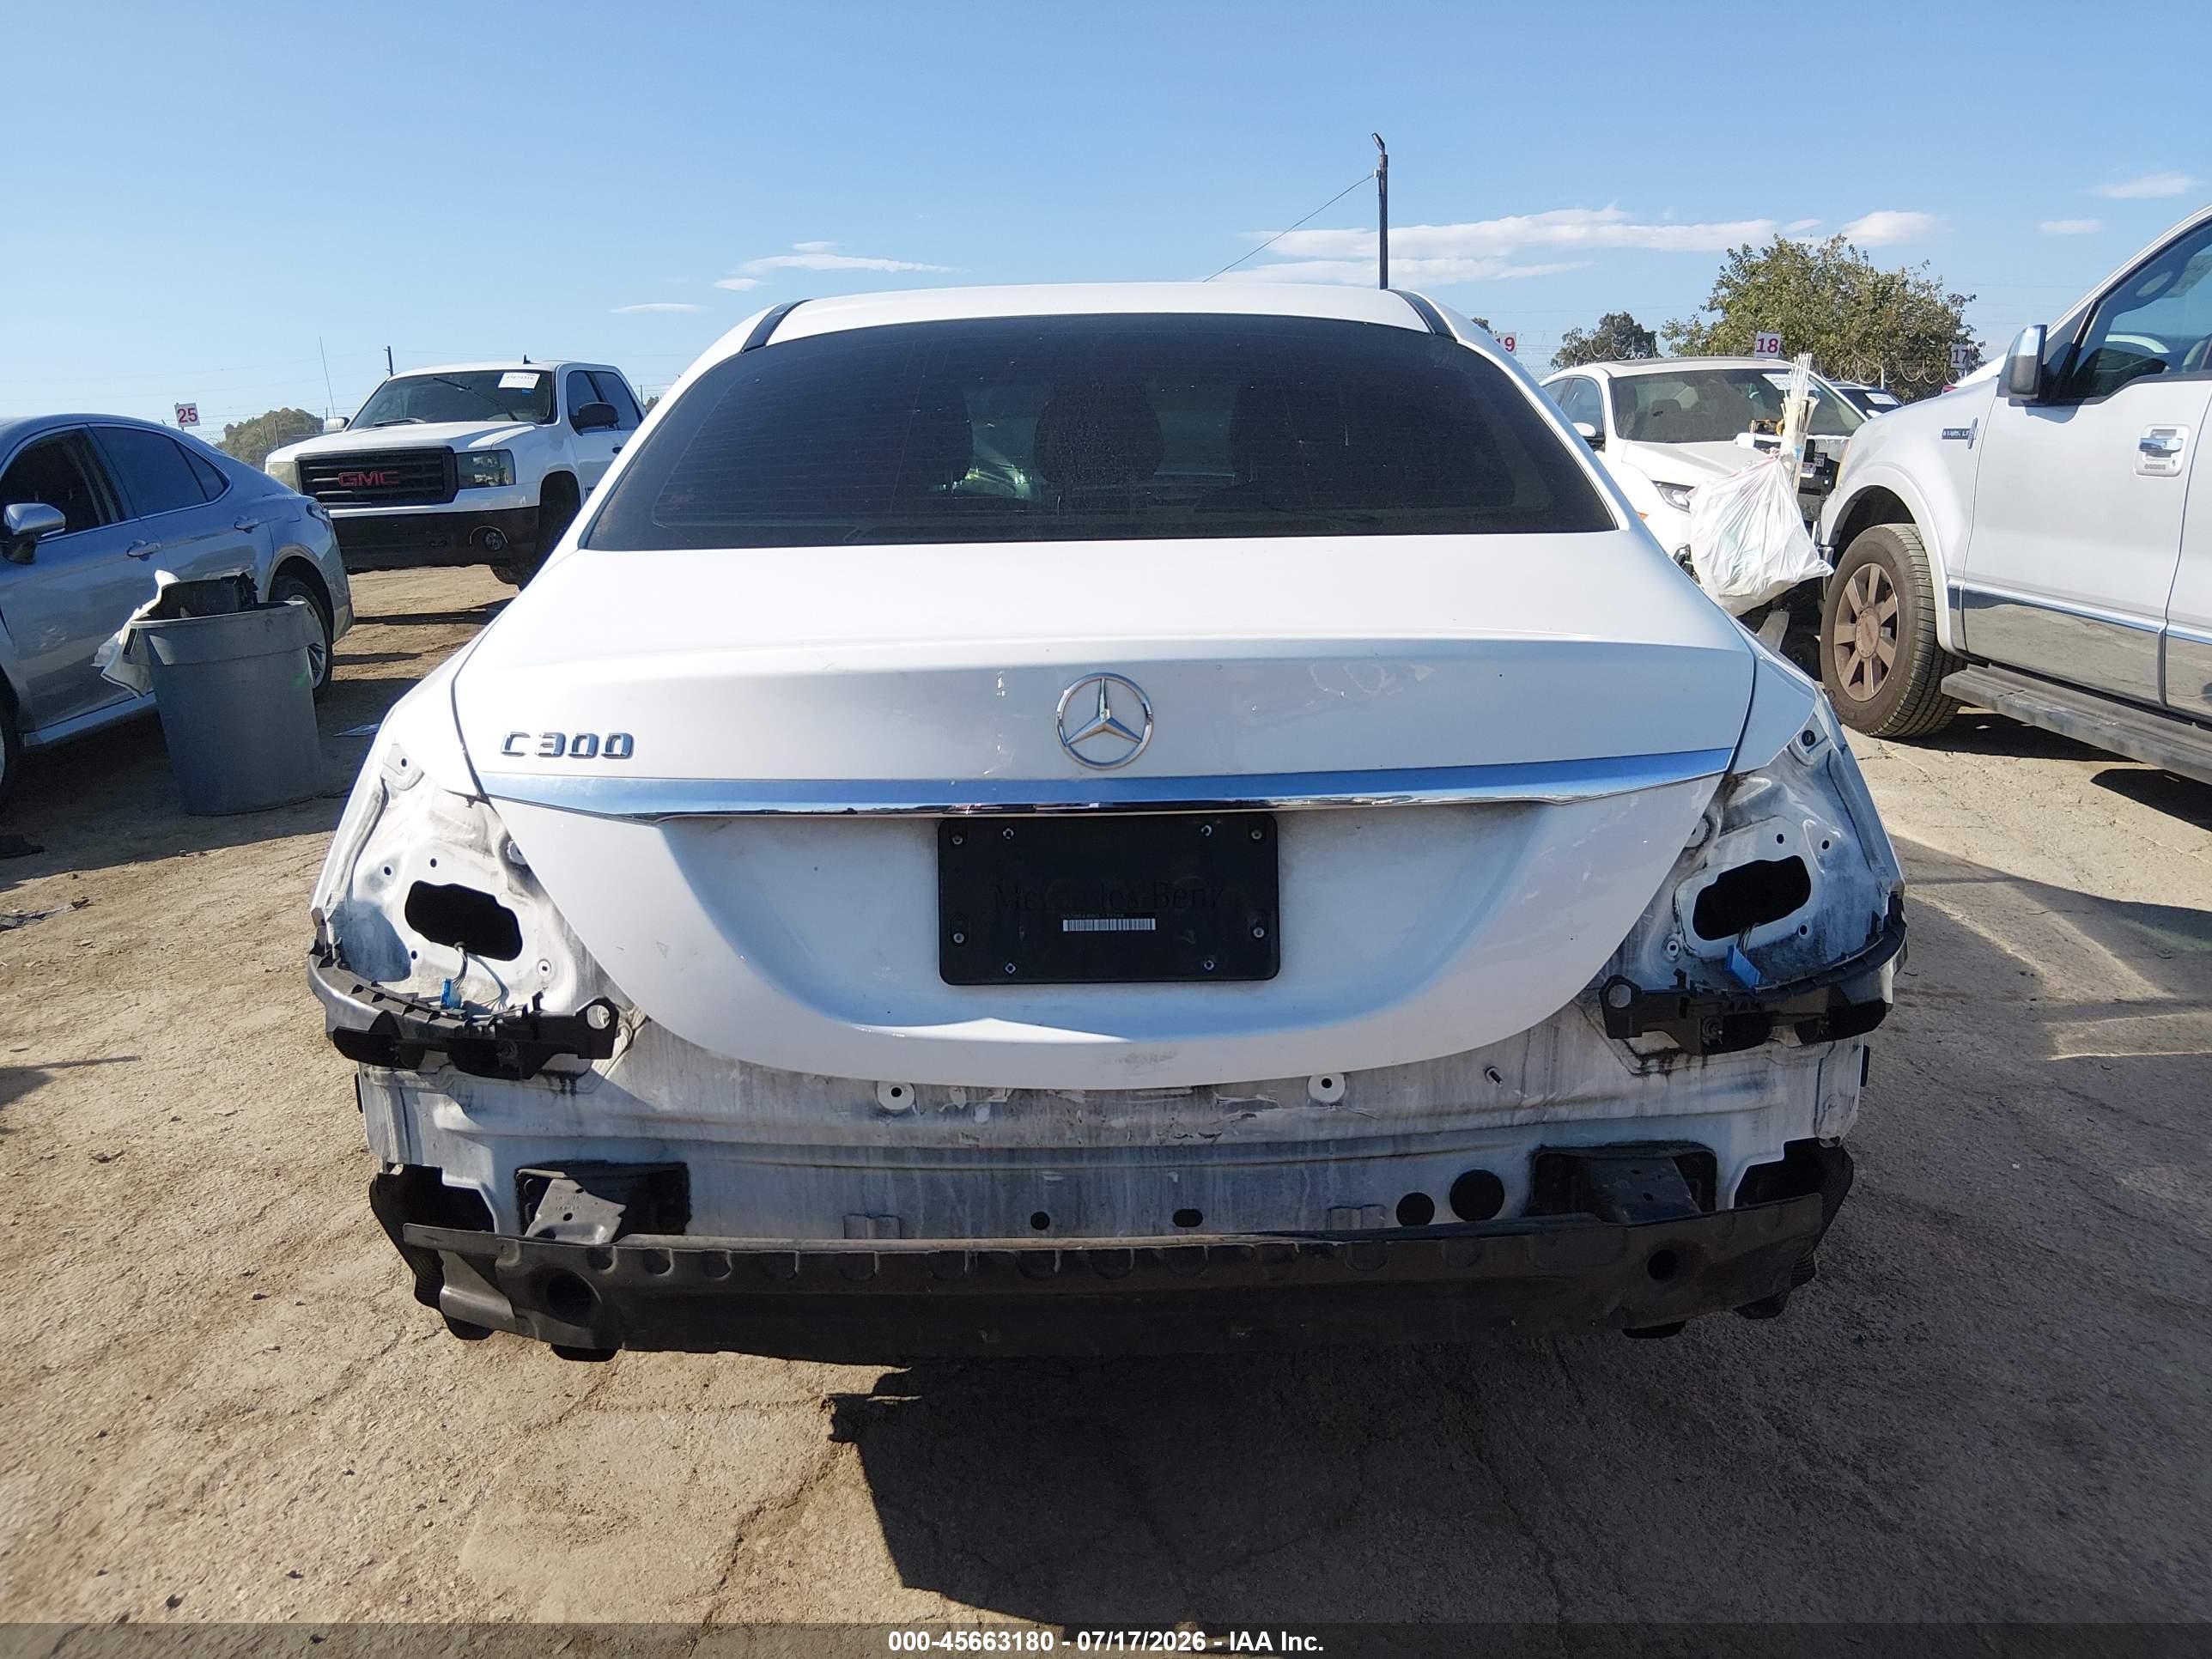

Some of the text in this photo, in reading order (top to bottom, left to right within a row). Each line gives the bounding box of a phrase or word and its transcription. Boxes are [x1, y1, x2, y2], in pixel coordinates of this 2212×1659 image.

[1756, 337, 1778, 353] 18
[1953, 349, 1969, 364] 17
[177, 407, 198, 422] 25
[337, 471, 400, 487] GMC
[994, 881, 1224, 914] Mees-Benz
